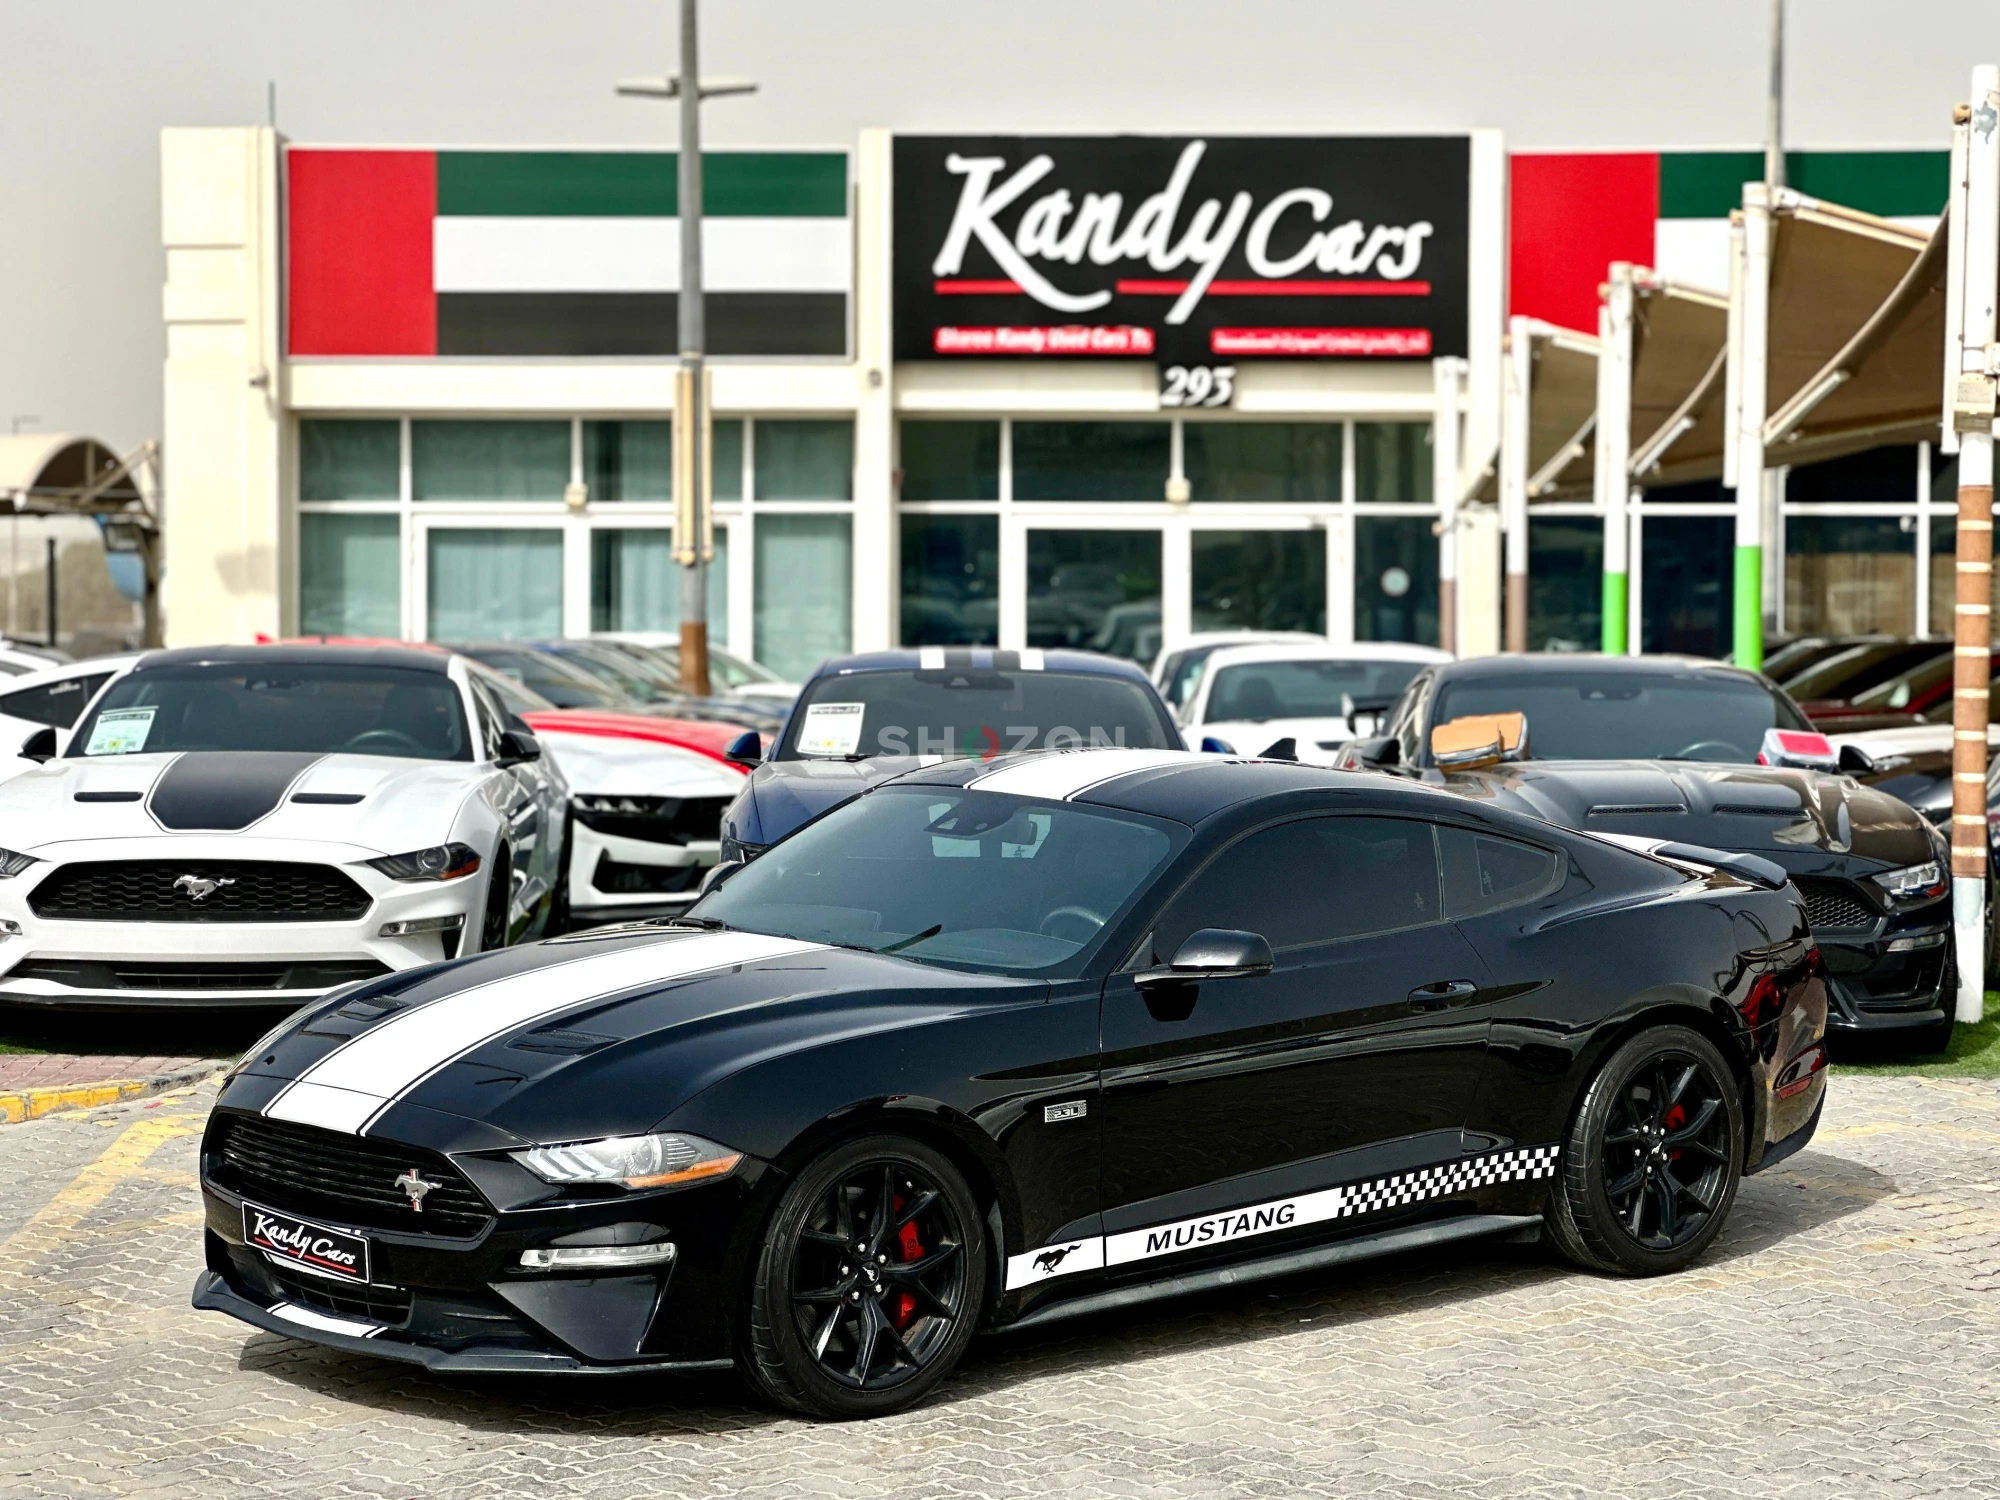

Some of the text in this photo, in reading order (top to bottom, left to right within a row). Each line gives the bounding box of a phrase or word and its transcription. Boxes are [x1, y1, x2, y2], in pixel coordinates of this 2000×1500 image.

[933, 139, 1434, 324] Kandy Cars
[1160, 365, 1237, 407] 295
[253, 1211, 356, 1265] Kandy Cars
[1146, 1203, 1296, 1254] MUSTANG
